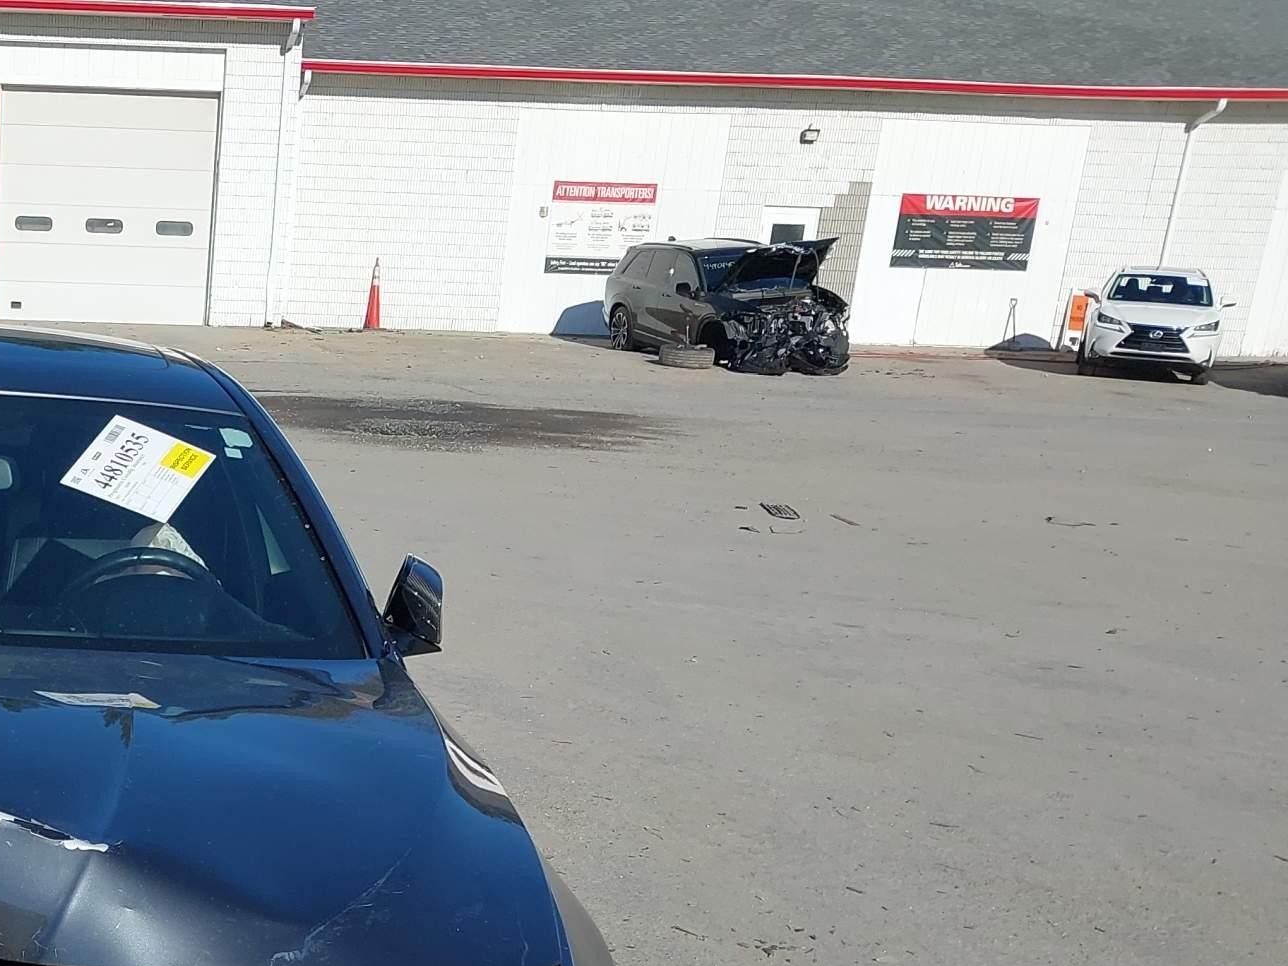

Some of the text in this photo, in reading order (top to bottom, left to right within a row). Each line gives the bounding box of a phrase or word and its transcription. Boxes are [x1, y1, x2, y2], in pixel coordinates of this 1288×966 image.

[556, 185, 654, 199] ATTENTION TRANSPORTERS!
[925, 195, 1015, 213] WARNING
[94, 432, 151, 490] 44810535
